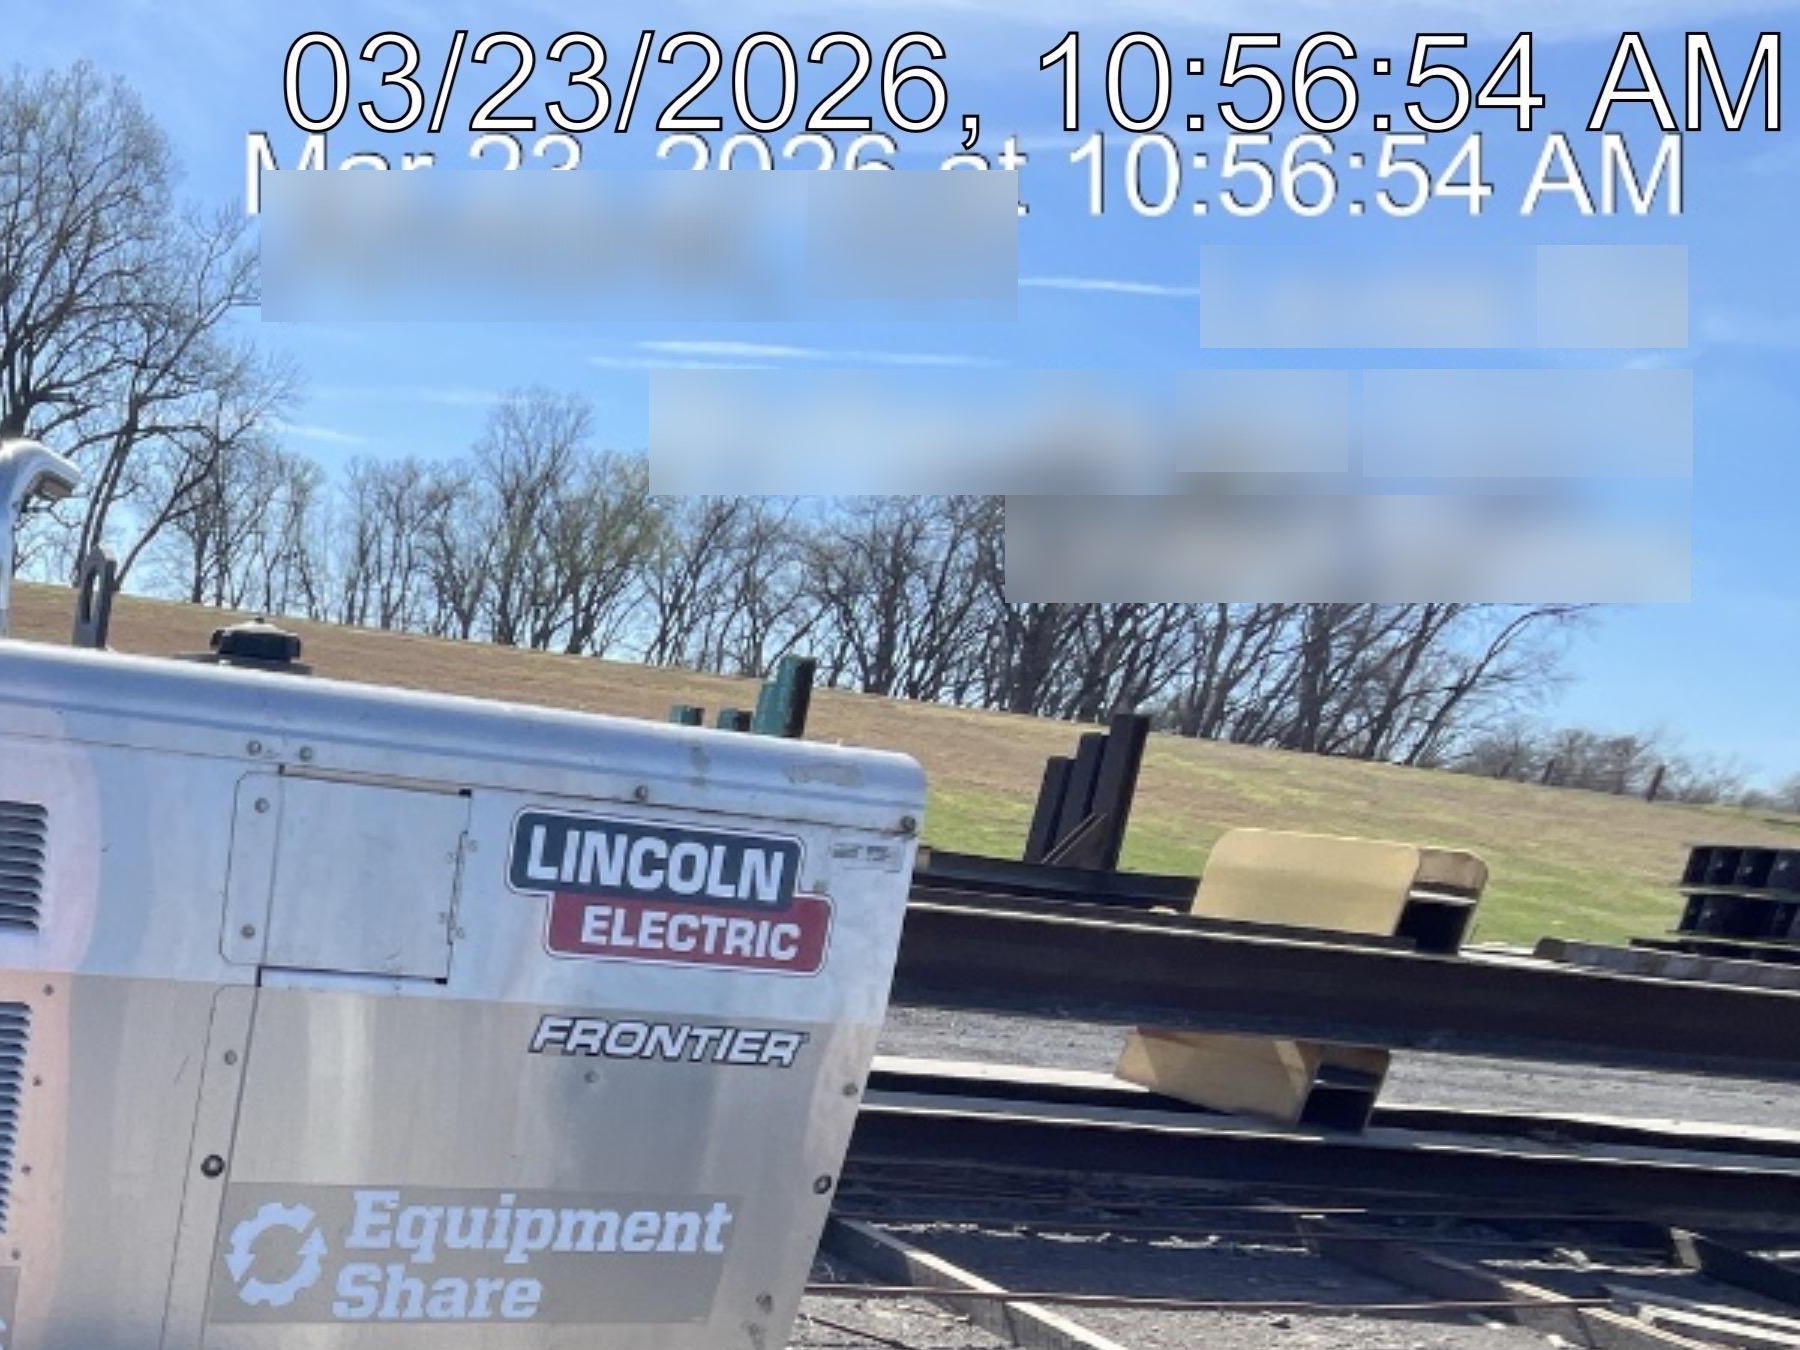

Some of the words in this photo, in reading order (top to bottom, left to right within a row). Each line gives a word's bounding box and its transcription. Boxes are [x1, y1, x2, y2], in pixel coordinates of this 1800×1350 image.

[525, 824, 785, 902] LINCOLN
[580, 905, 802, 961] ELECTRIC
[529, 1015, 806, 1067] FRONTIER
[343, 1190, 733, 1265] Equipment
[331, 1262, 545, 1319] Share
